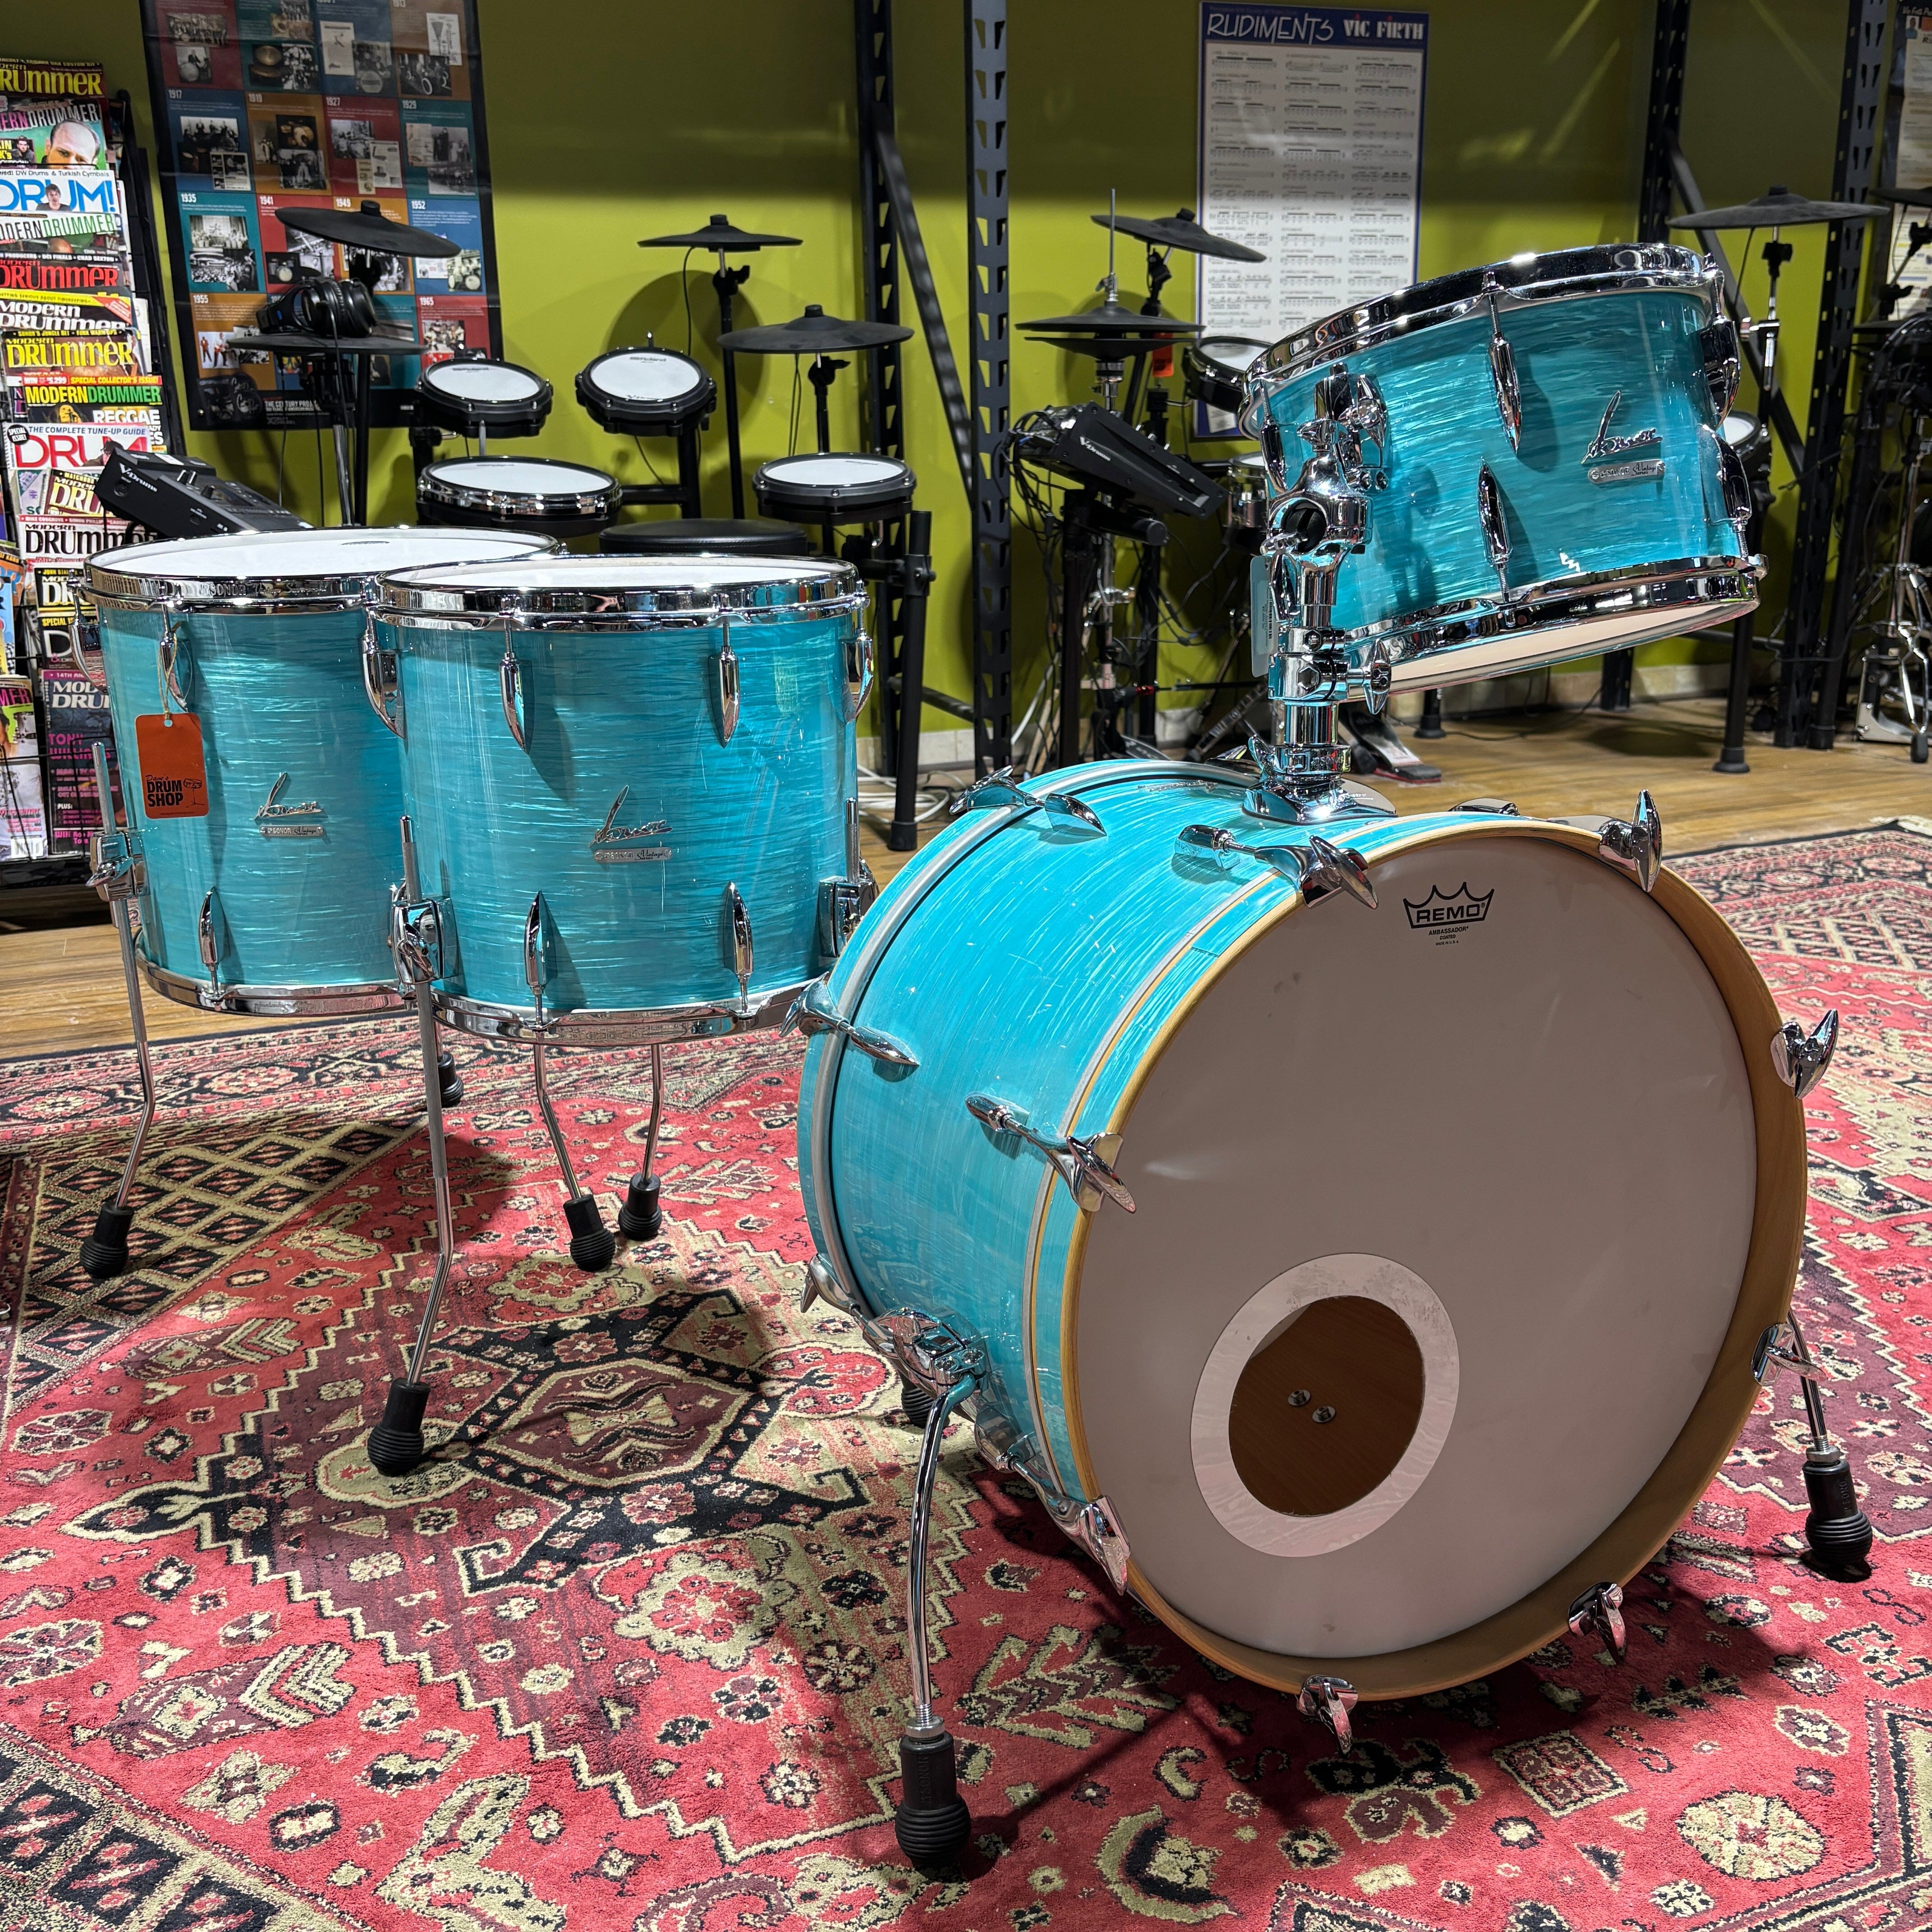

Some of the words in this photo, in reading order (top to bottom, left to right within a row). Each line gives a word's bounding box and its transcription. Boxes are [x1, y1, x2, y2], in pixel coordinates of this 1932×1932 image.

[1207, 13, 1334, 45] RUDIMENTS
[1343, 14, 1370, 37] VIC
[1376, 15, 1425, 40] FIRTH
[168, 90, 182, 99] 1917
[326, 97, 340, 106] 1927
[181, 193, 197, 203] 1935
[259, 196, 274, 206] 1941
[411, 200, 426, 209] 1952
[193, 294, 208, 304] 1955
[420, 297, 434, 306] 1965
[25, 386, 89, 404] MODERN
[87, 386, 161, 403] DRUMMER
[92, 409, 161, 425] REGGAE
[45, 426, 85, 434] COMPLETE
[87, 427, 121, 435] TUNE-UP
[42, 617, 67, 626] SPECIAL
[147, 780, 182, 793] DRUM
[147, 792, 184, 807] SHOP
